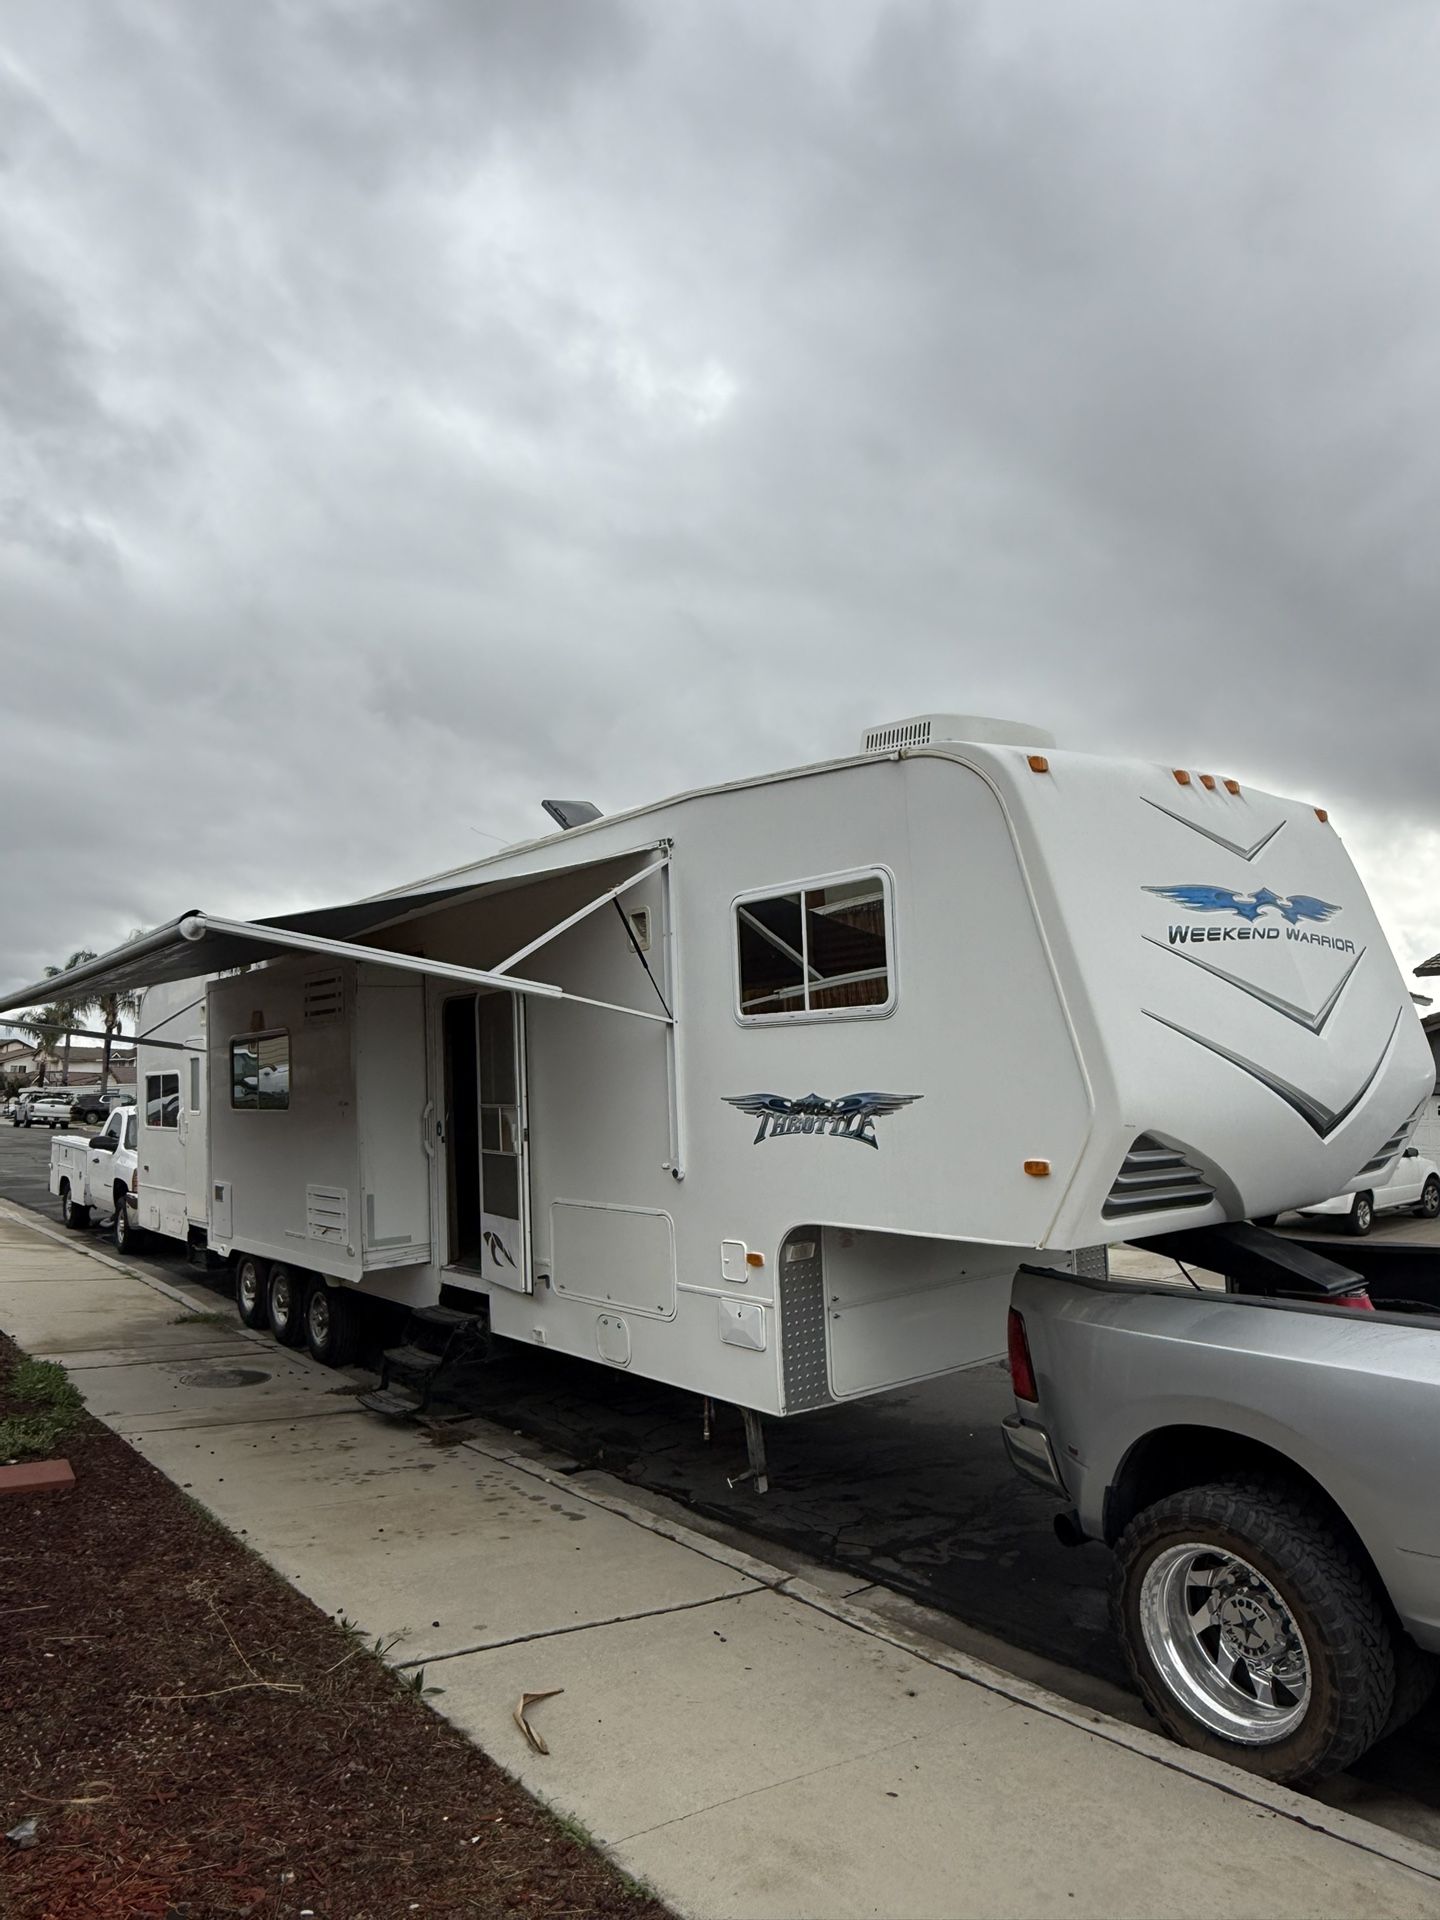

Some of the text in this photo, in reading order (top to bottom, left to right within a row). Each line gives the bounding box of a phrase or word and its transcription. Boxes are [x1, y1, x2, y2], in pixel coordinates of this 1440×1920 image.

[1168, 925, 1356, 954] WEEKEND WARRIOR
[754, 1105, 882, 1150] THROTTLE
